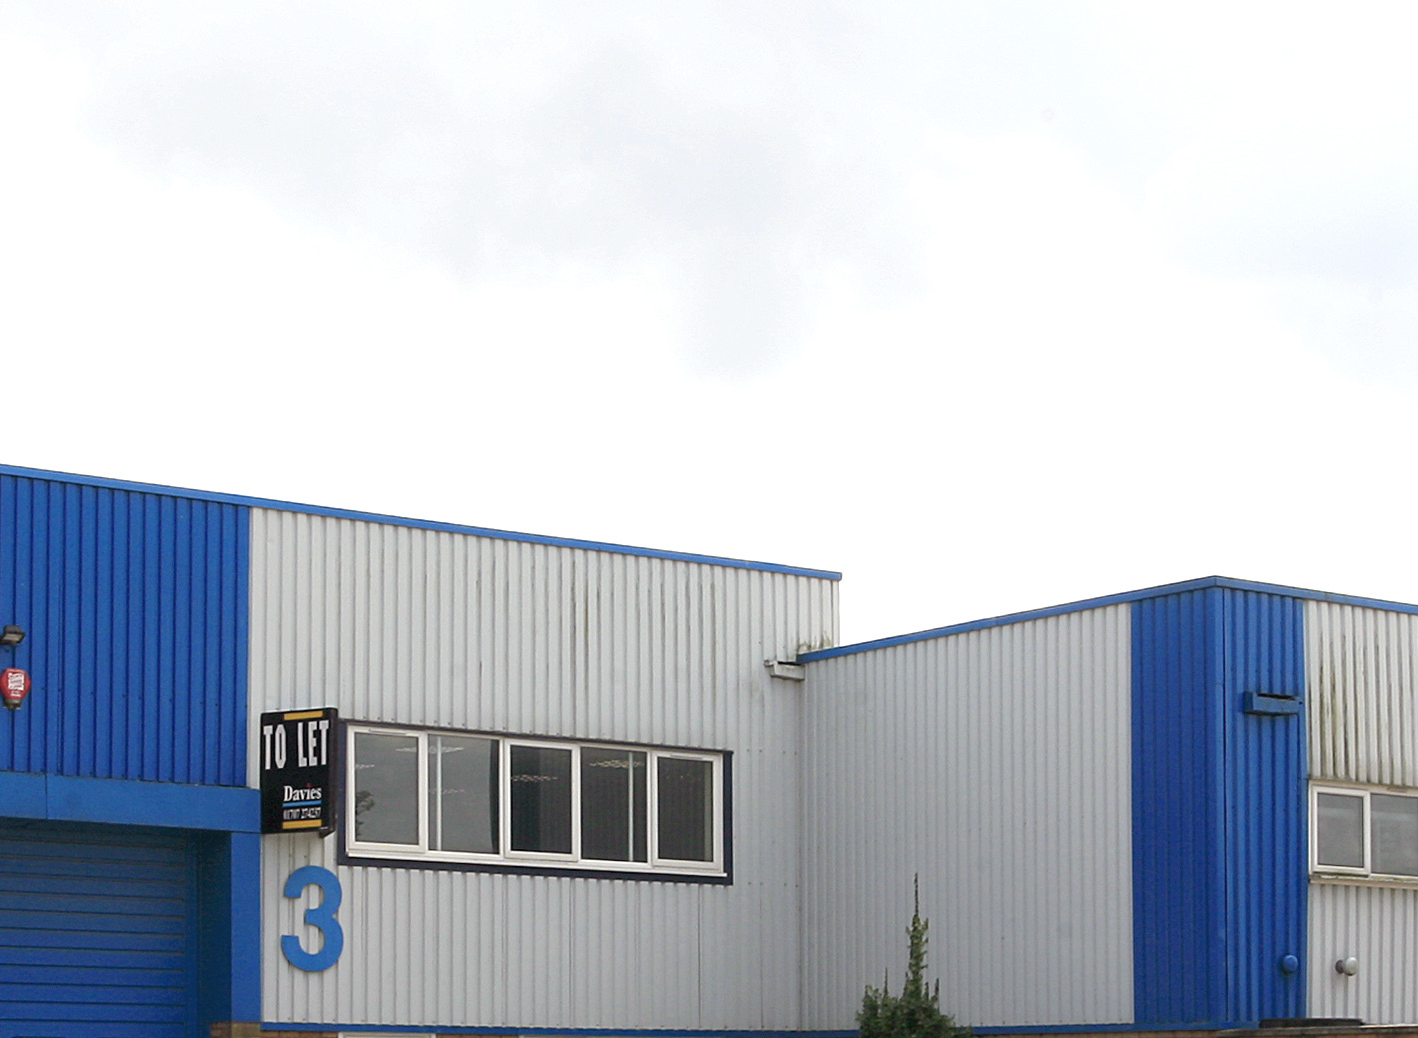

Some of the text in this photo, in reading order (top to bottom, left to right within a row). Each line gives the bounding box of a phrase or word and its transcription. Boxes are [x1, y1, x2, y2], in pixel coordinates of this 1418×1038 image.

[263, 719, 330, 771] TO LET
[283, 785, 322, 802] Davies
[281, 865, 344, 972] 3
